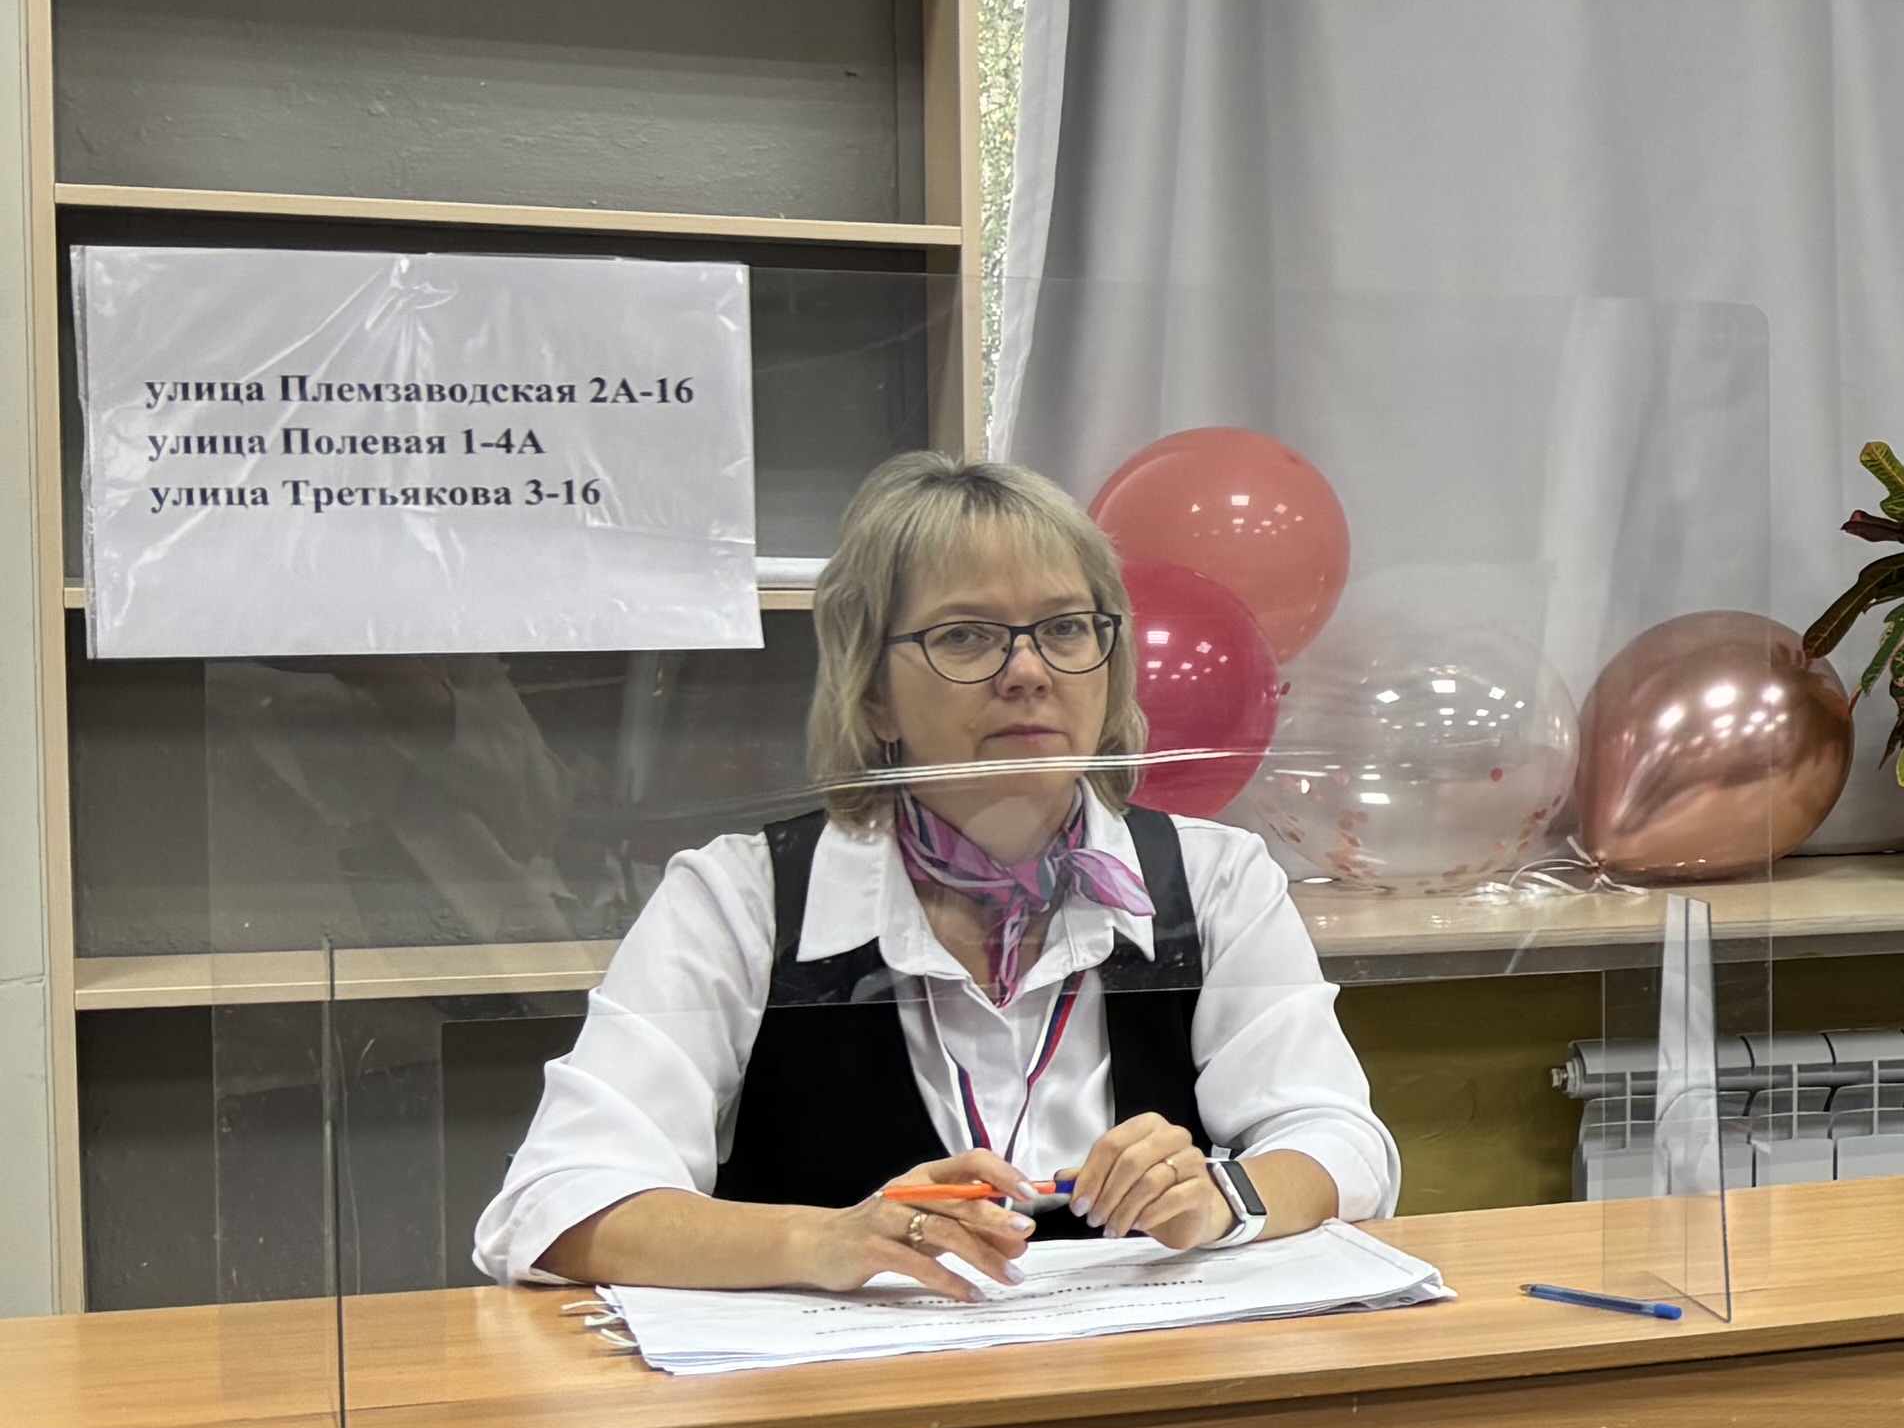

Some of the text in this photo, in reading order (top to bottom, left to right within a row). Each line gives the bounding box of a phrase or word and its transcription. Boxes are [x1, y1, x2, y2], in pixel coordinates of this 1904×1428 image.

[145, 374, 695, 410] улица Племзаводская 2А-16
[148, 427, 546, 459] улица Полевая 1-4А
[150, 478, 601, 514] улица Третьякова 3-16
